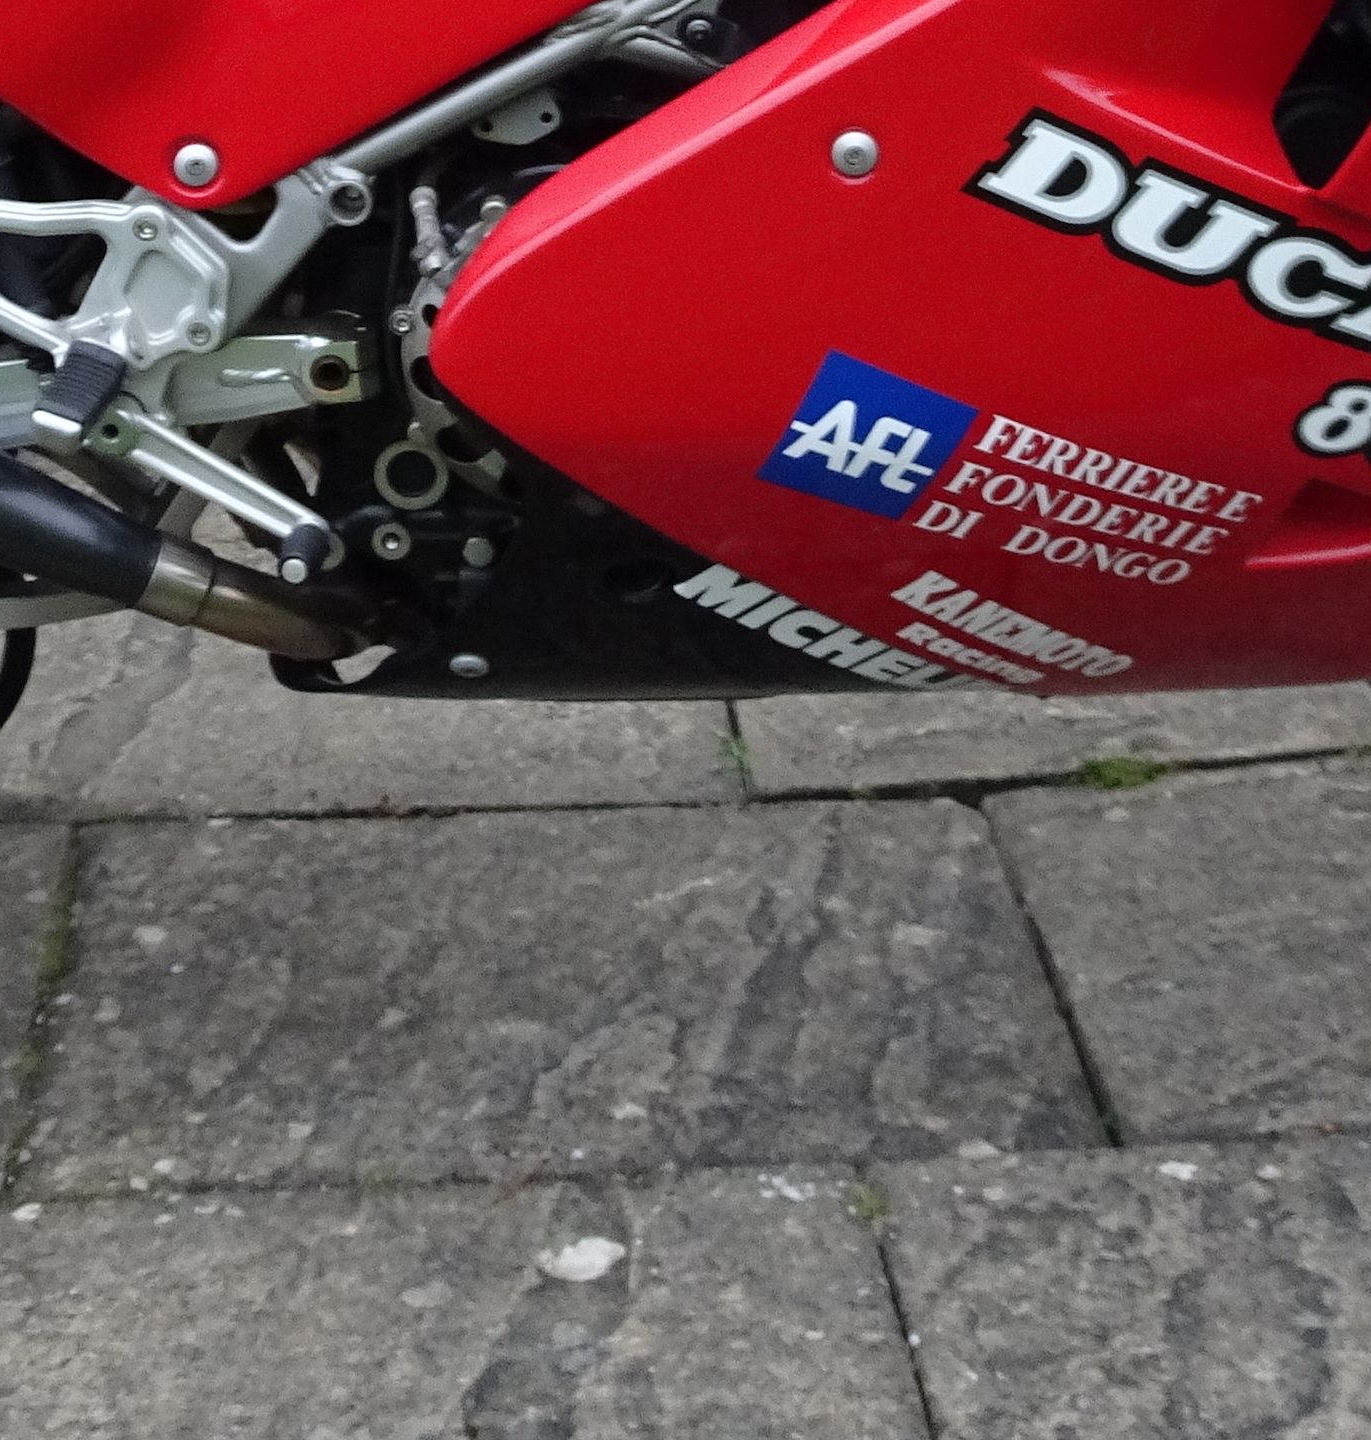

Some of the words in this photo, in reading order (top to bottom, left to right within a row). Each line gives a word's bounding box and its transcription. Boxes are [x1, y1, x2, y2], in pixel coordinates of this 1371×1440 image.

[943, 461, 1229, 555] FONDERIE
[973, 414, 1225, 514] FERRIERE
[912, 500, 984, 540] DI
[1001, 524, 1191, 585] DONGO
[672, 562, 974, 693] MICHEL
